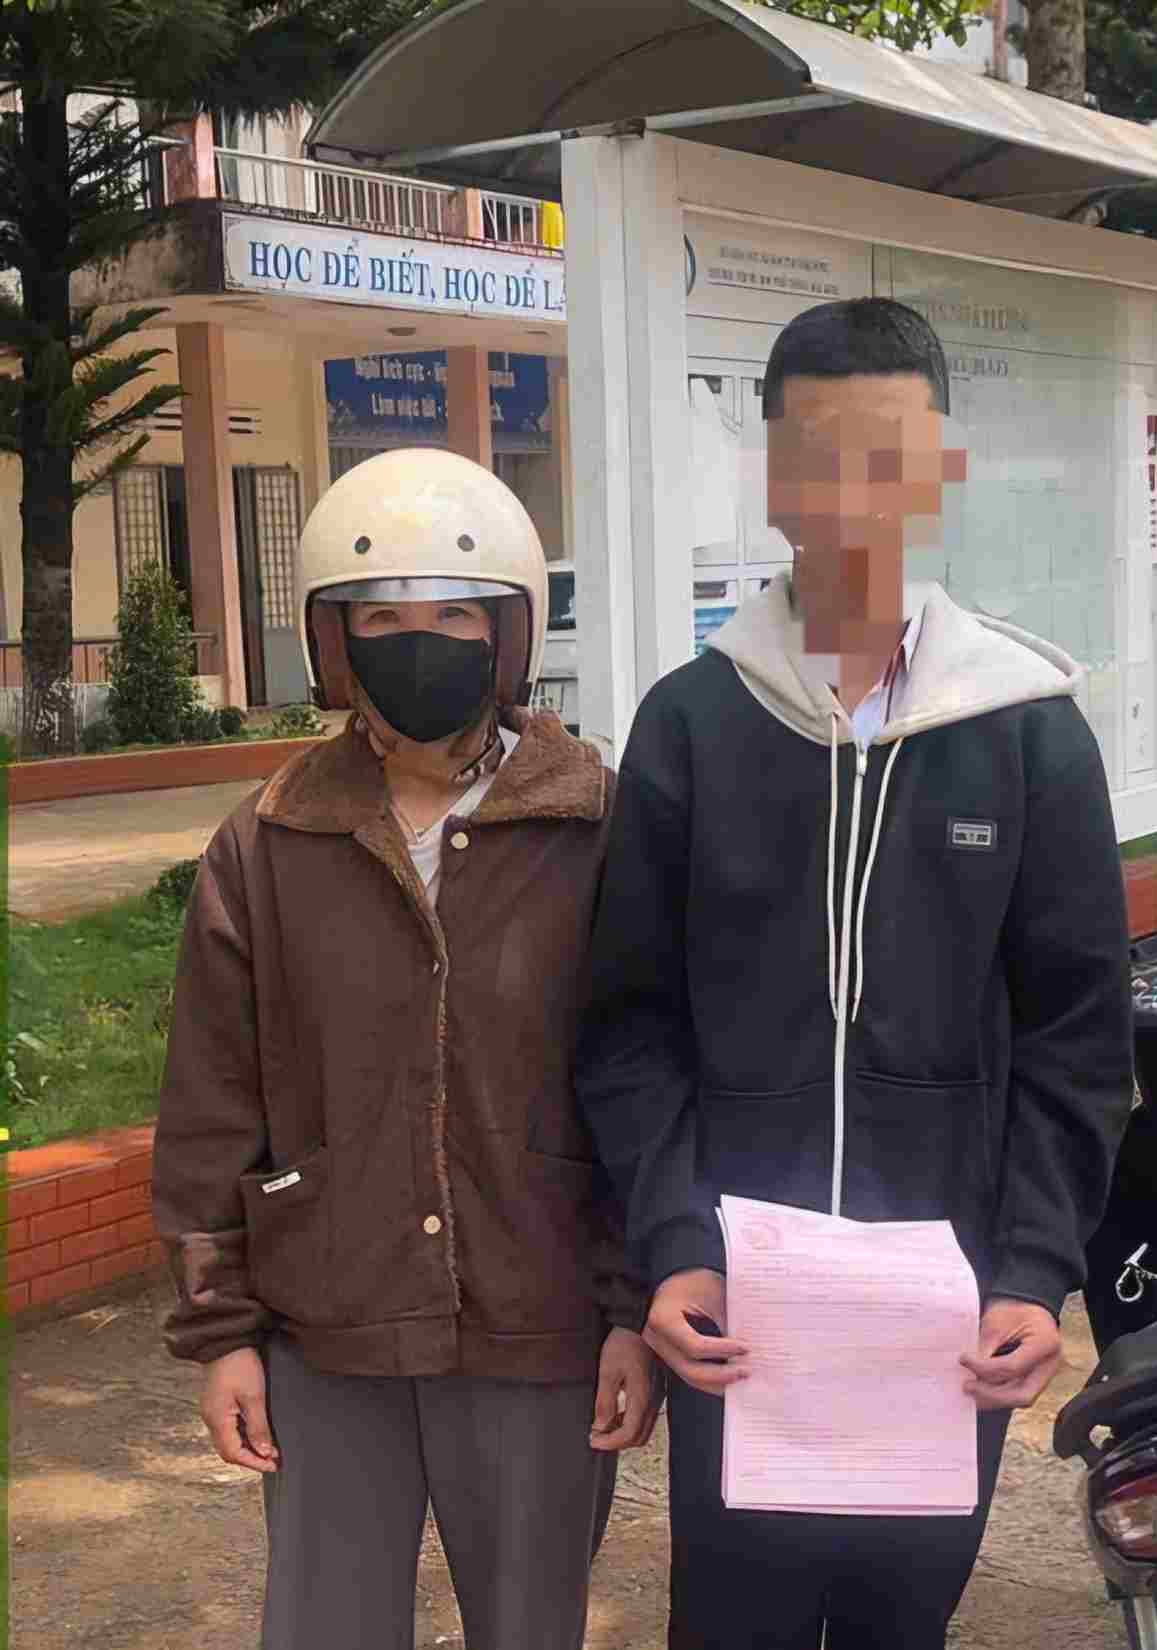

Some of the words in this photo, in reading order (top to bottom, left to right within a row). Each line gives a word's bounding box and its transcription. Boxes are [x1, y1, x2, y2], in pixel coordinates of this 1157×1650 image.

[249, 240, 312, 288] HỌC
[322, 237, 360, 288] ĐỂ
[369, 248, 436, 300] BIẾT,
[444, 266, 496, 312] HỌC
